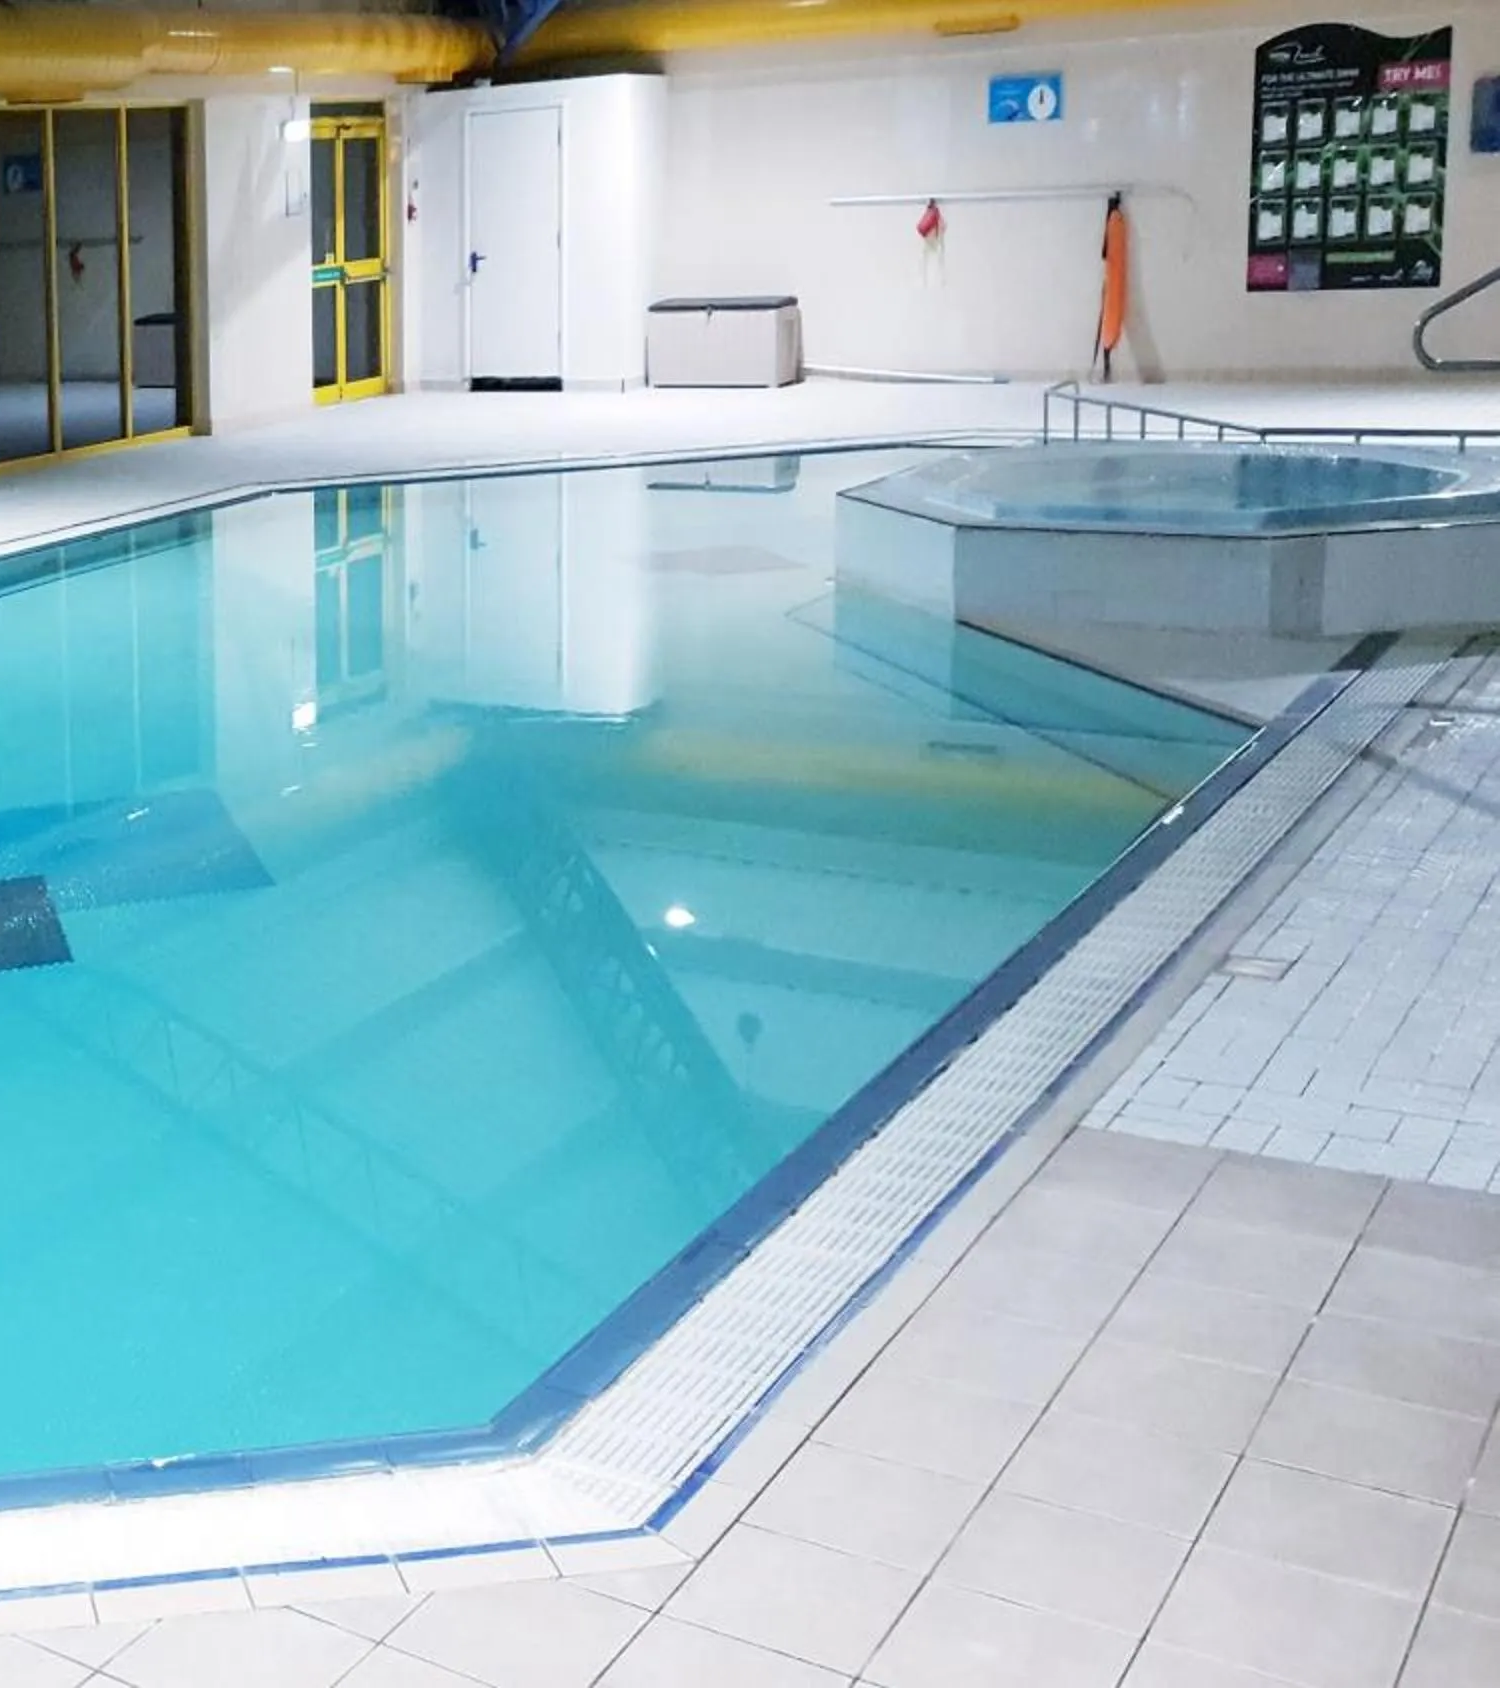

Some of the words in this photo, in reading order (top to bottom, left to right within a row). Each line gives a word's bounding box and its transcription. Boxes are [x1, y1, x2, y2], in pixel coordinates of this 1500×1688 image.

[1261, 74, 1278, 84] FOR
[1280, 72, 1294, 82] THE
[1297, 69, 1334, 81] ULTIMATE
[1384, 66, 1410, 81] TRY
[1414, 64, 1441, 80] ME!
